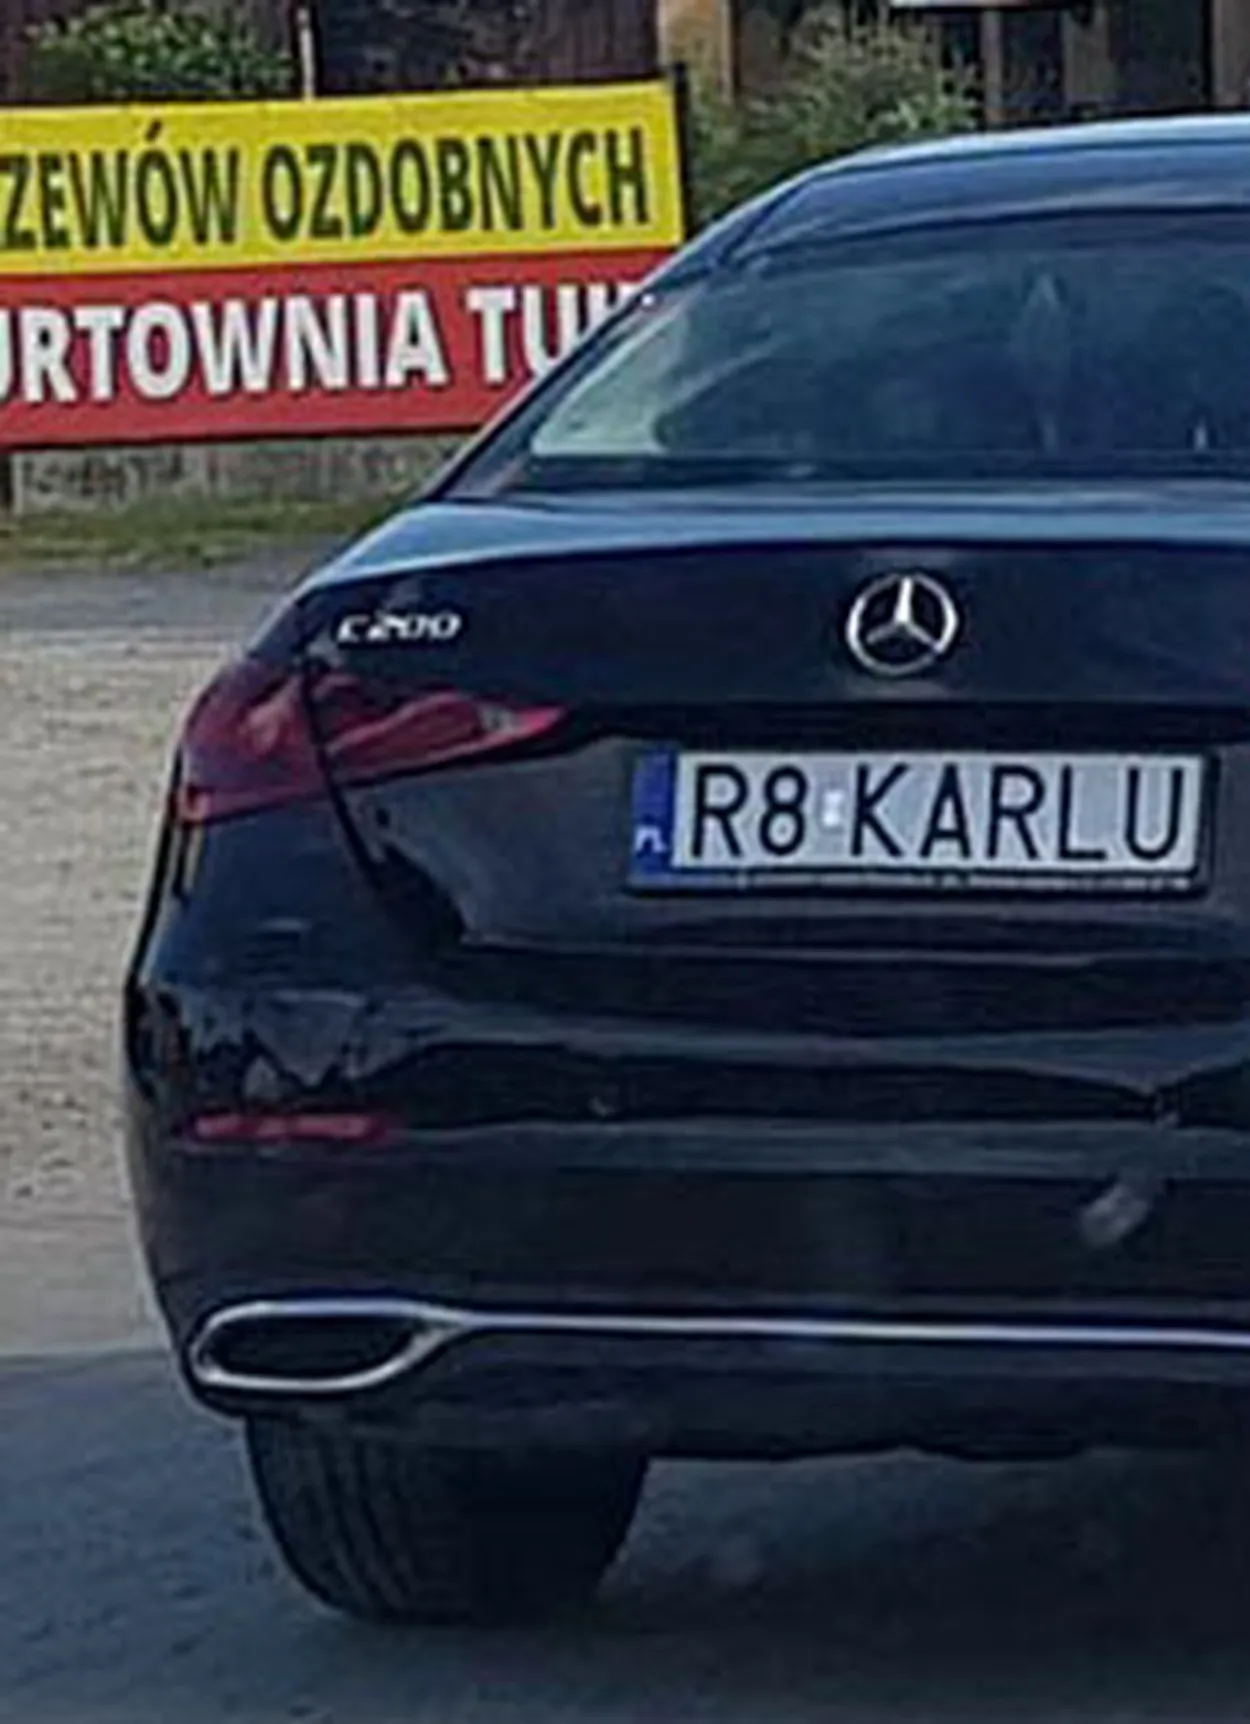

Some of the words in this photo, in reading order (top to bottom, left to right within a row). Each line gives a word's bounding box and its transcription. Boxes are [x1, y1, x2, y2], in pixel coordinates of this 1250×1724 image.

[262, 129, 649, 242] OZDOBNYCH
[0, 291, 448, 402] RTOWNIA
[690, 763, 808, 857] R8
[850, 763, 1185, 860] KARLU
